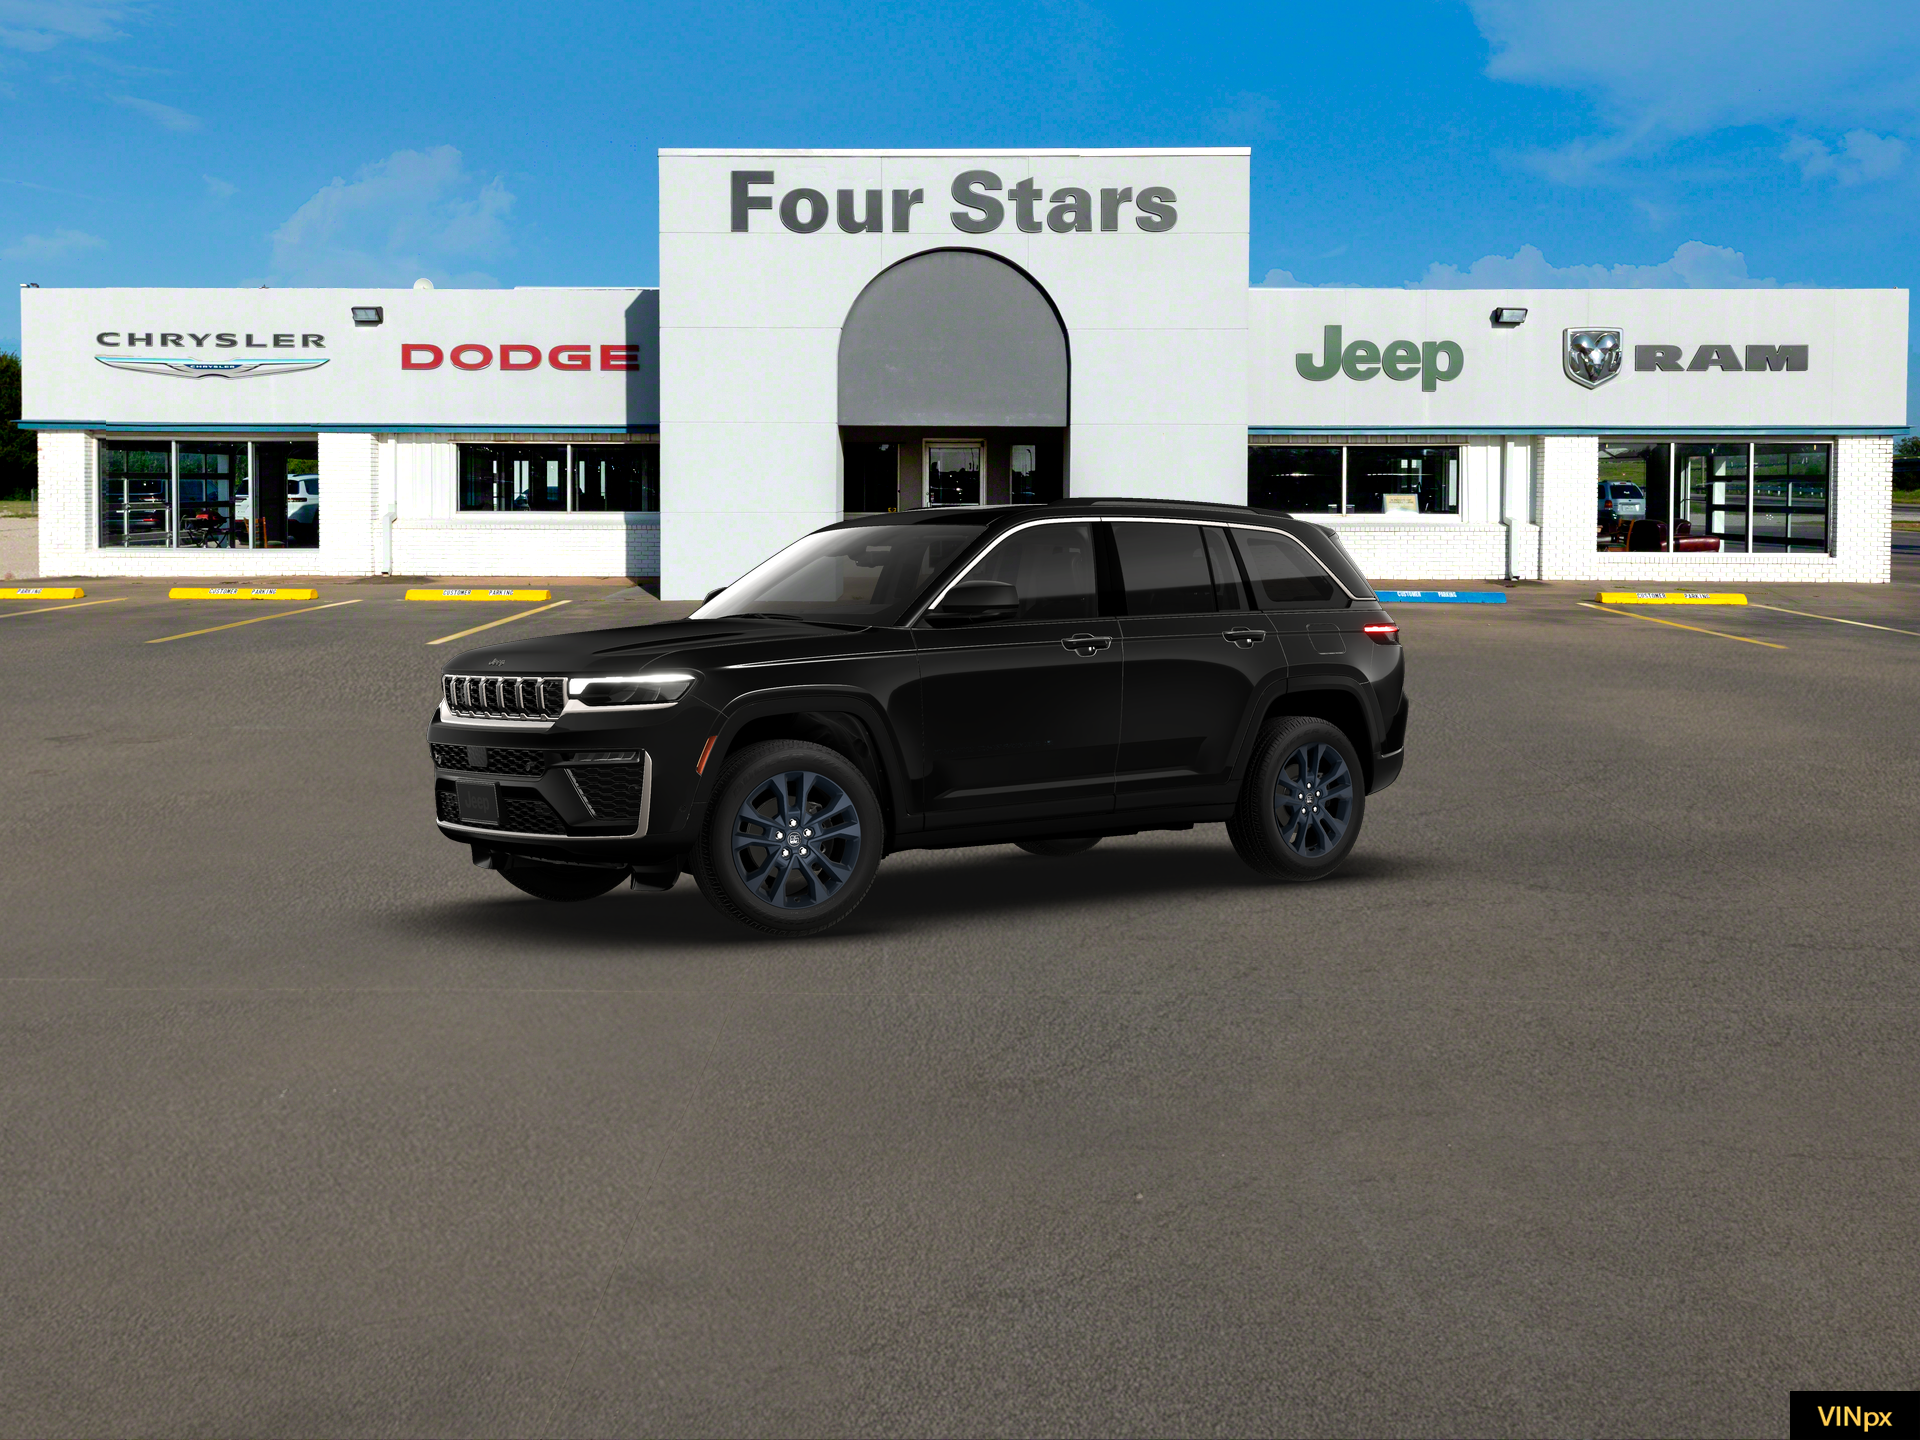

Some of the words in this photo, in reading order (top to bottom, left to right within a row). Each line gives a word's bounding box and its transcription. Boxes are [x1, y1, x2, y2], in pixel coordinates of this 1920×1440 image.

[730, 169, 924, 233] Four
[950, 169, 1178, 233] Stars
[96, 331, 327, 348] CHRYSLER
[401, 343, 640, 371] DODGE
[1295, 324, 1464, 392] Jeep
[1634, 344, 1809, 372] RAM
